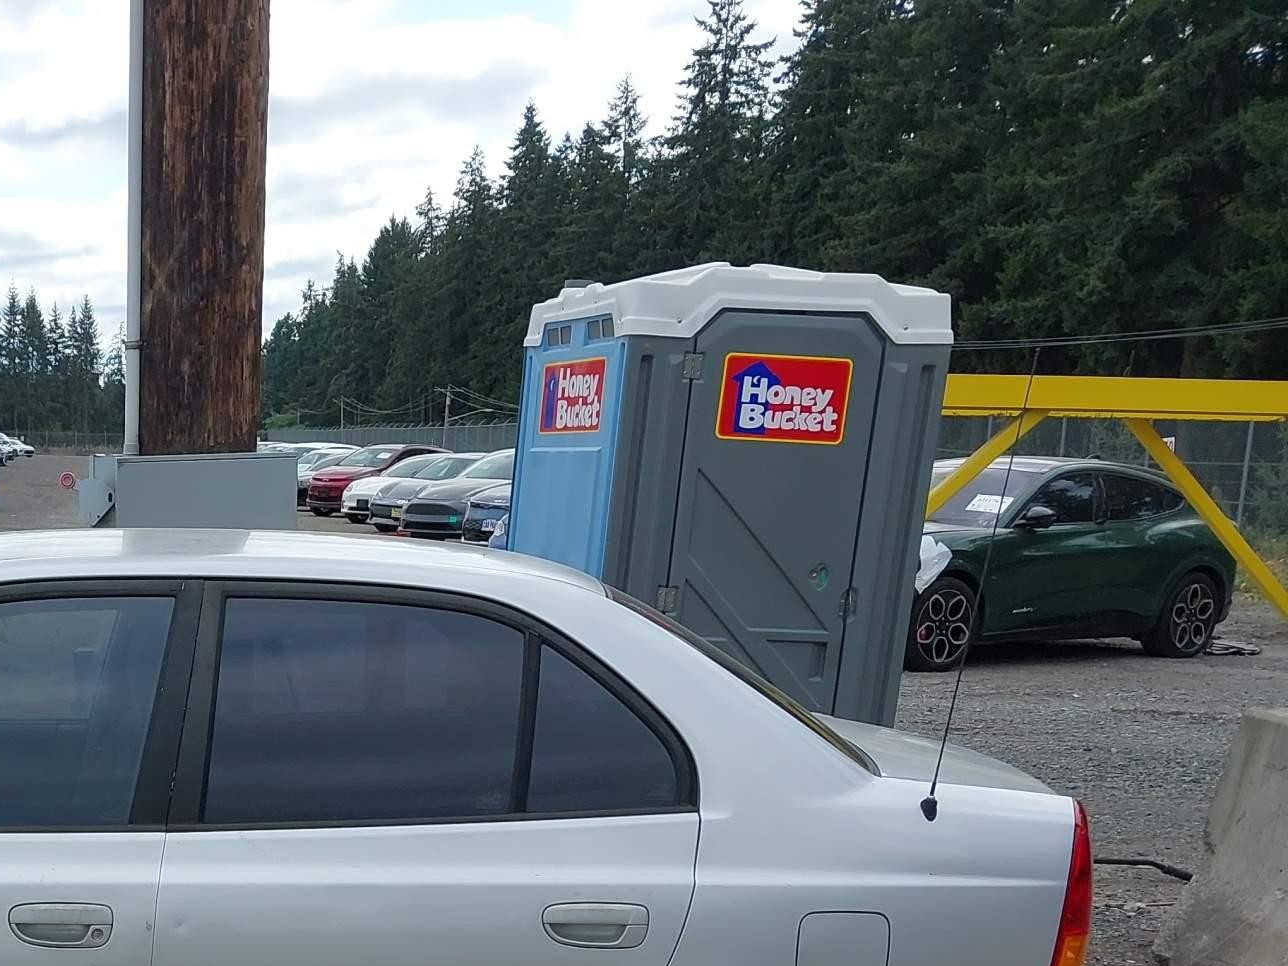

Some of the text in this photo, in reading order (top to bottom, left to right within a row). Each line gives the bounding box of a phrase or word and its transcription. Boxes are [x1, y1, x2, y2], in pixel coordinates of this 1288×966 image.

[558, 367, 600, 403] Honey
[741, 375, 834, 412] Honey
[555, 395, 600, 429] Bucket
[738, 403, 838, 432] Bucket
